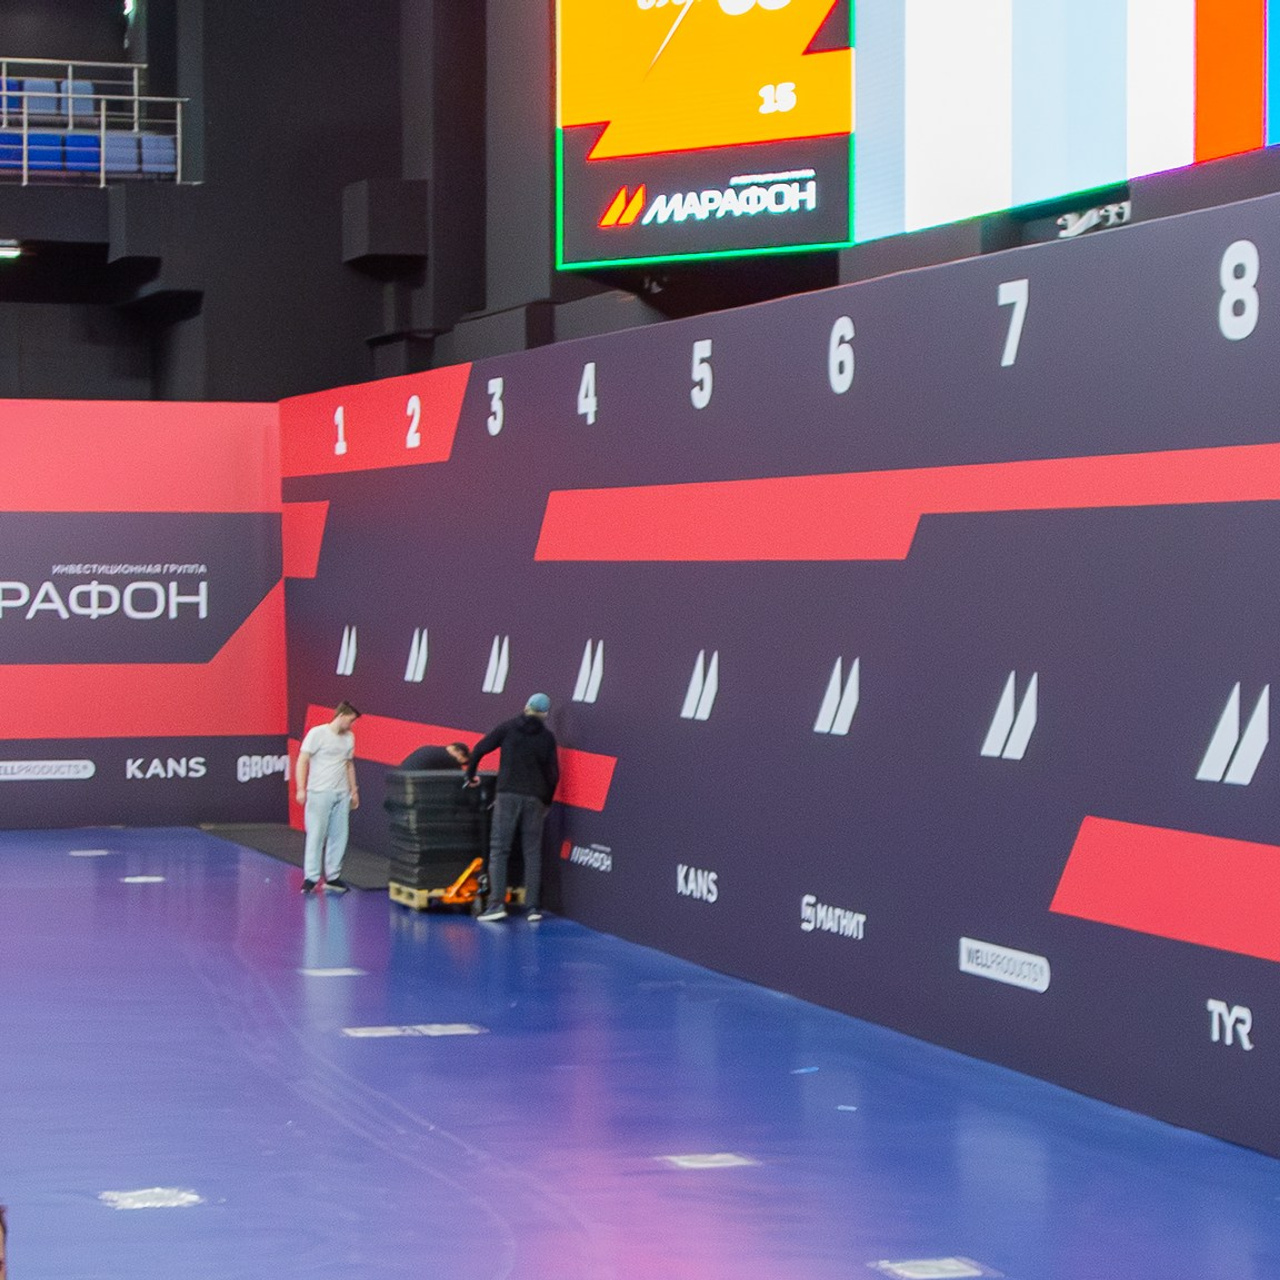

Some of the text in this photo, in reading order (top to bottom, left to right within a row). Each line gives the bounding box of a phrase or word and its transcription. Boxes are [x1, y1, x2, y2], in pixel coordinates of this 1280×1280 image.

[759, 82, 797, 114] 15
[642, 181, 816, 225] МАРАФОН
[1218, 239, 1260, 340] 8
[998, 278, 1029, 367] 7
[691, 339, 713, 409] 5
[828, 315, 855, 394] 6
[487, 377, 503, 436] 3
[577, 362, 598, 425] 4
[334, 405, 347, 455] 1
[406, 395, 421, 448] 2
[52, 563, 208, 575] ИНВЕСТИЦИОННАЯ ГРУППА
[126, 757, 207, 779] KANS
[676, 864, 719, 903] KANS
[816, 903, 867, 939] МАГНИТ
[1207, 999, 1254, 1051] TYR
